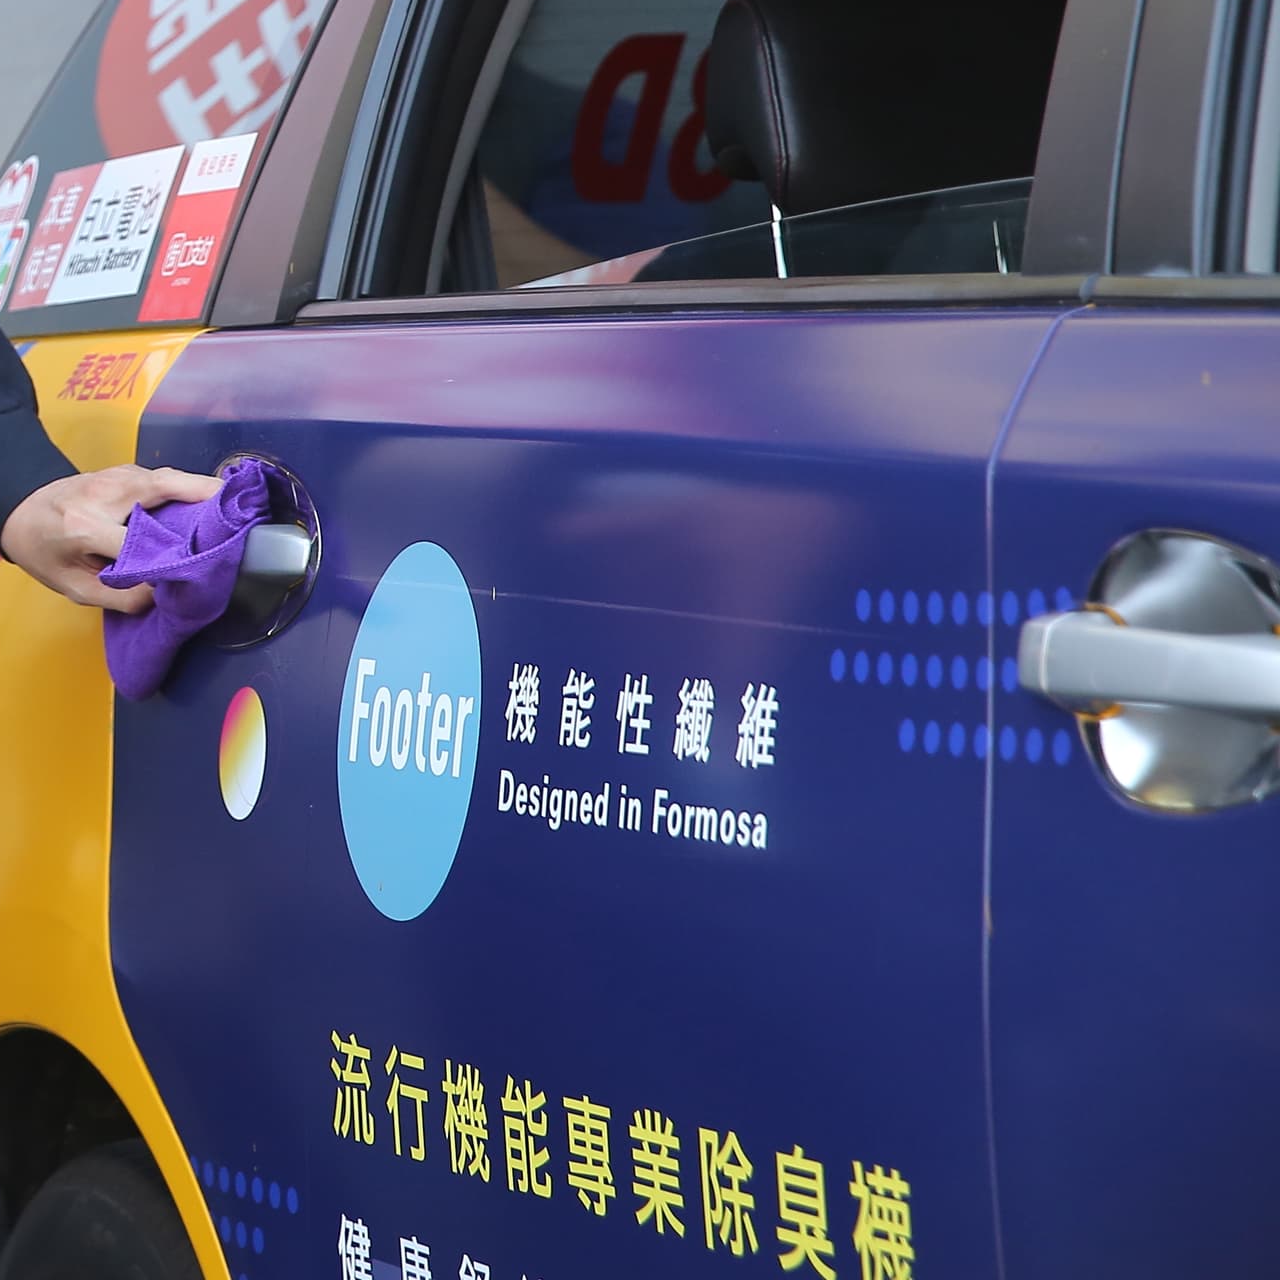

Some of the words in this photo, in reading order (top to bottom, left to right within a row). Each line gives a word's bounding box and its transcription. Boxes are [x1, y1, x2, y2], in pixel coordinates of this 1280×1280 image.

[101, 247, 144, 273] Battery
[347, 657, 476, 779] Footer
[504, 662, 780, 770] 機能性纖維
[497, 768, 611, 831] Designed
[617, 784, 643, 832] in
[650, 788, 769, 849] Formosa
